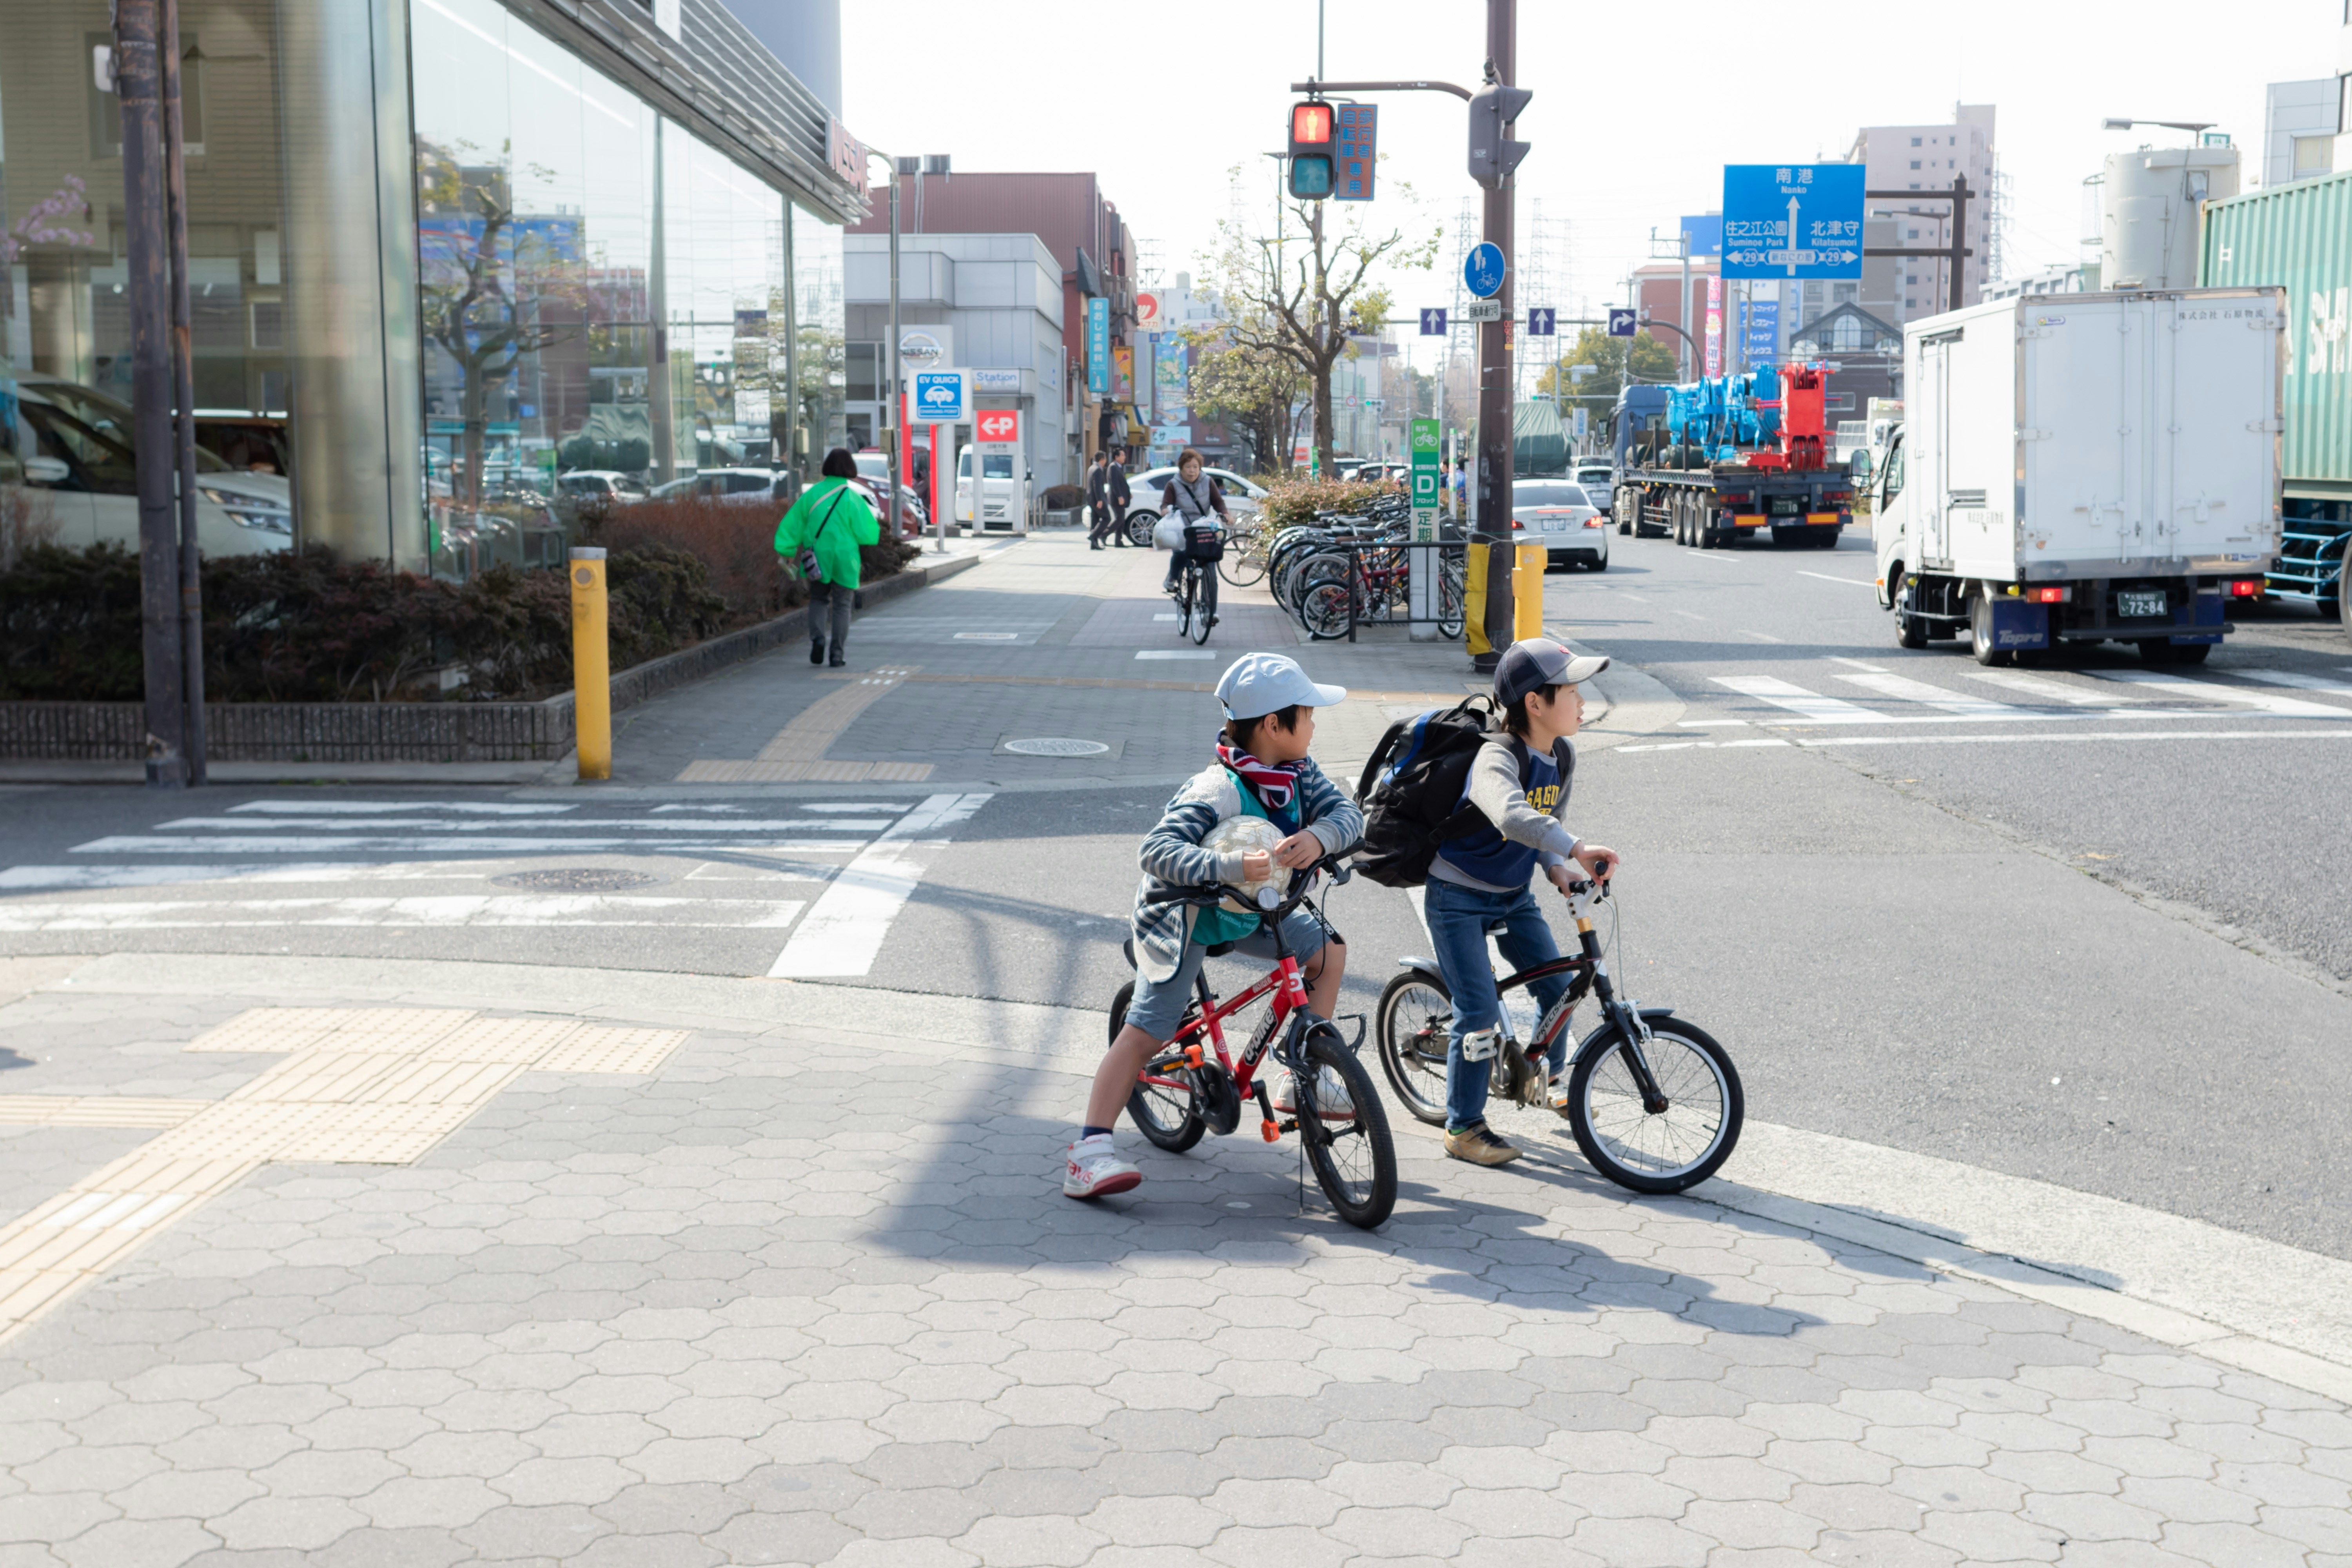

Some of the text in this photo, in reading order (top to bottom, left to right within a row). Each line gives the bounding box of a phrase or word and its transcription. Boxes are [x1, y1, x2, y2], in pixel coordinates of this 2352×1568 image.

[1341, 109, 1356, 158] 自転車
[1357, 110, 1372, 158] 歩行者
[1776, 168, 1813, 183] 南港
[1726, 221, 1788, 236] 住之江公園
[1810, 221, 1859, 236] 北津守
[1728, 238, 1784, 247] Suminoe Park
[1811, 238, 1857, 247] Kitatsumori
[1745, 252, 1756, 262] 29
[1827, 252, 1839, 262] 29
[1470, 304, 1499, 318] 自転車通行可
[1094, 301, 1103, 362] おおしま歯科
[977, 372, 1016, 381] Station
[999, 417, 1014, 435] P
[1417, 475, 1434, 493] D
[1418, 511, 1432, 542] 定期
[2129, 600, 2164, 615] 72-84
[1999, 630, 2043, 646] Topre
[1536, 987, 1570, 1041] PRECISION
